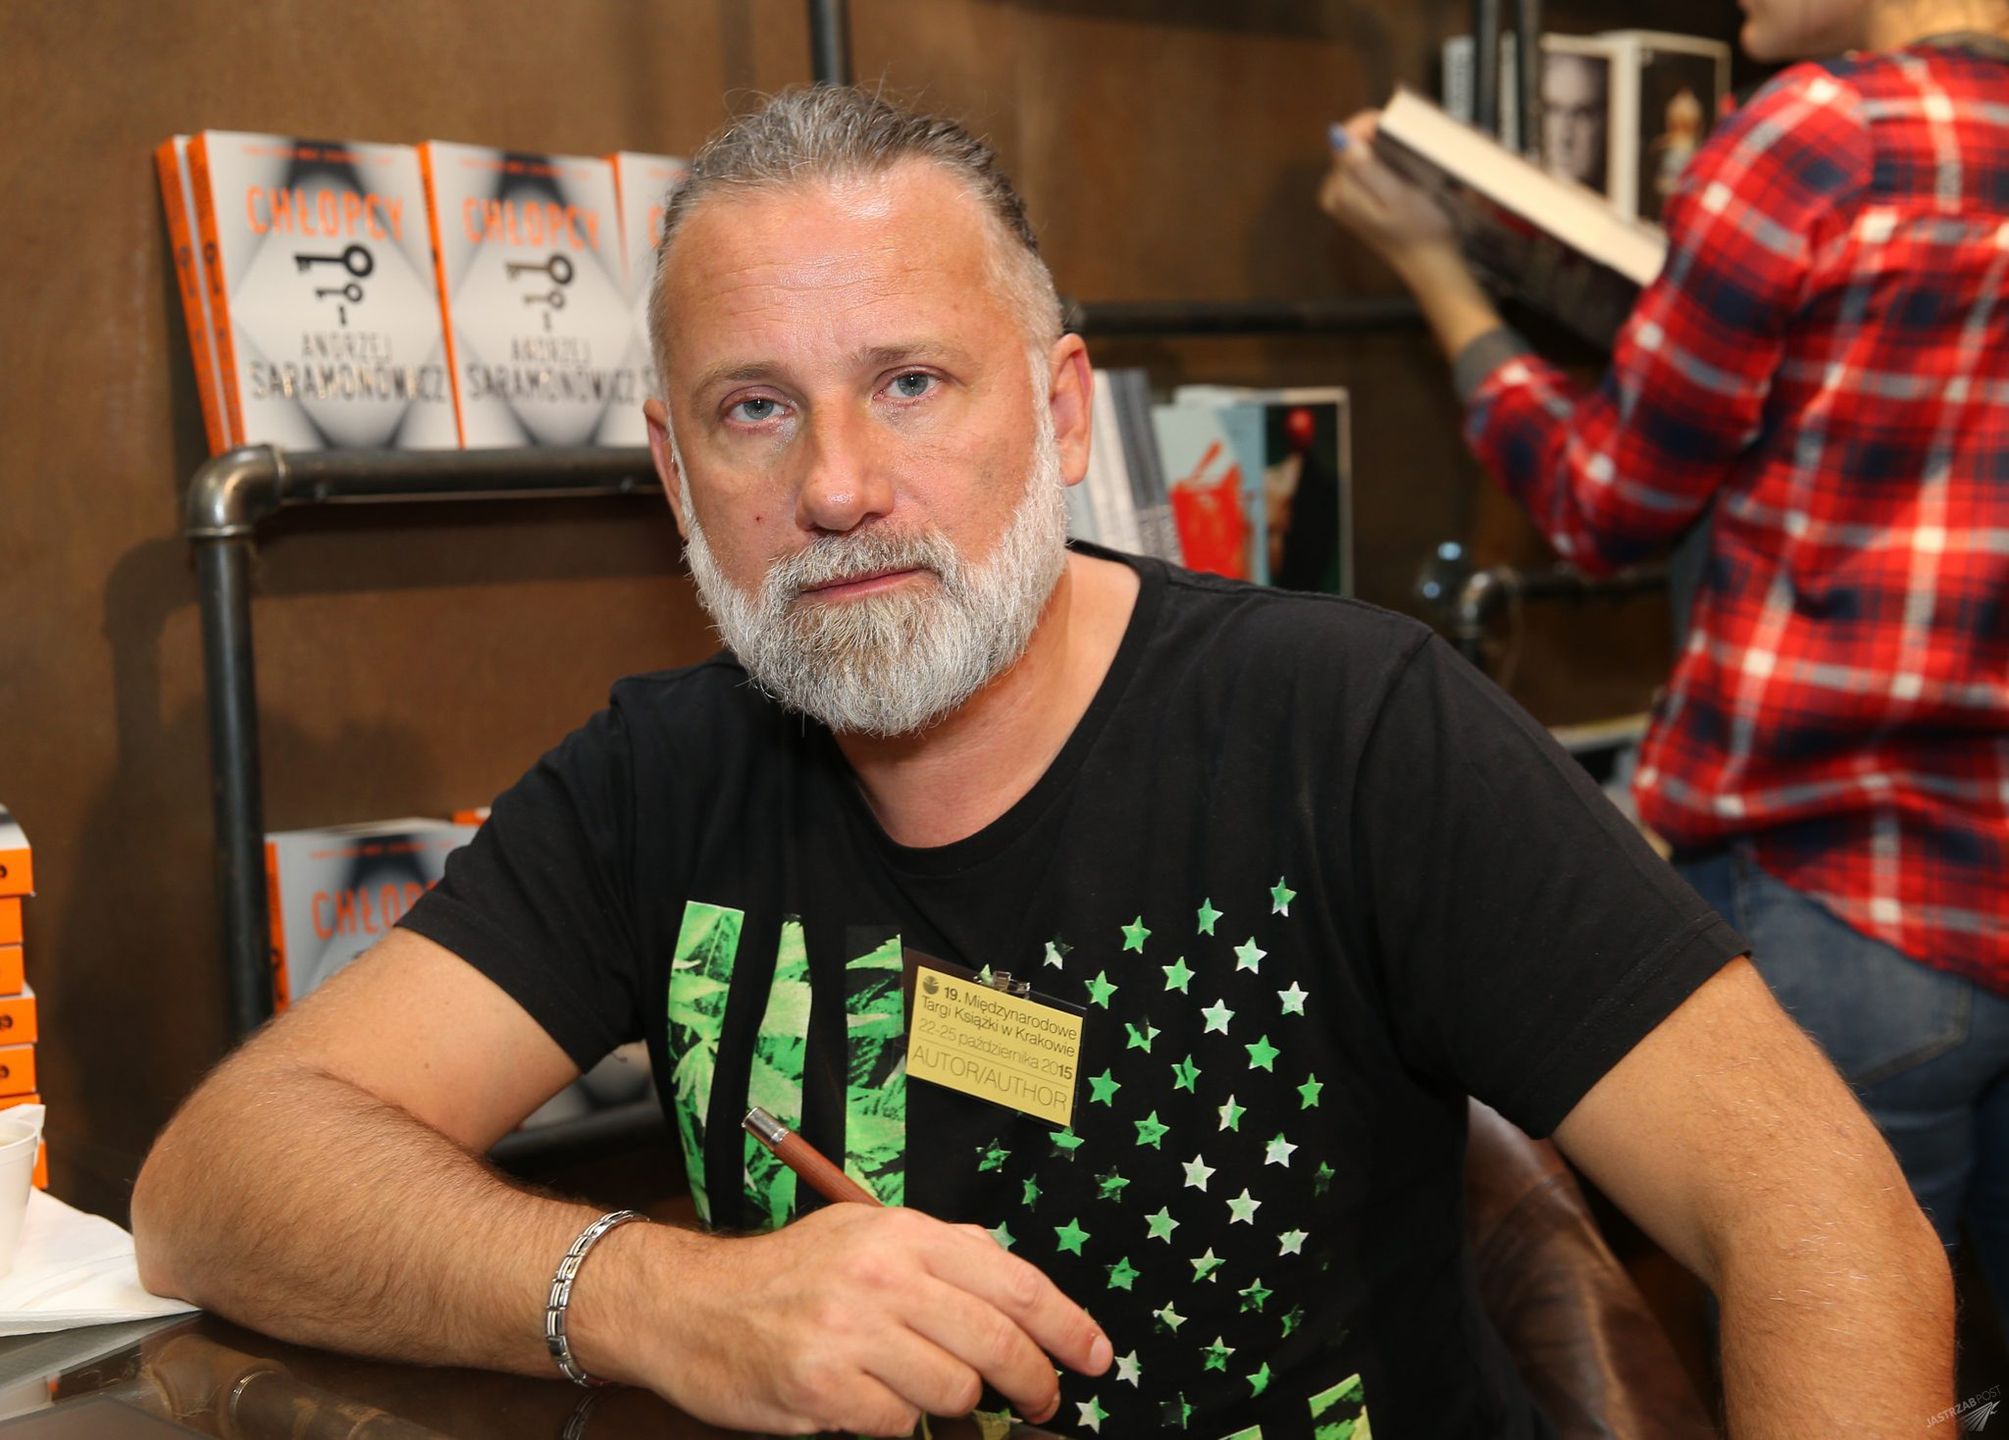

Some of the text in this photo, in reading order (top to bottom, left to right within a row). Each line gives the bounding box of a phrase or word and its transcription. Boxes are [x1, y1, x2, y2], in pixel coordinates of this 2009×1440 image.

[921, 995, 1076, 1057] Targi Książki w Krakowie
[944, 985, 1078, 1040] 19. Międzynarodowe
[912, 1045, 1067, 1112] AUTOR/AUTHOR
[918, 1018, 1073, 1080] 22-25 października 2015
